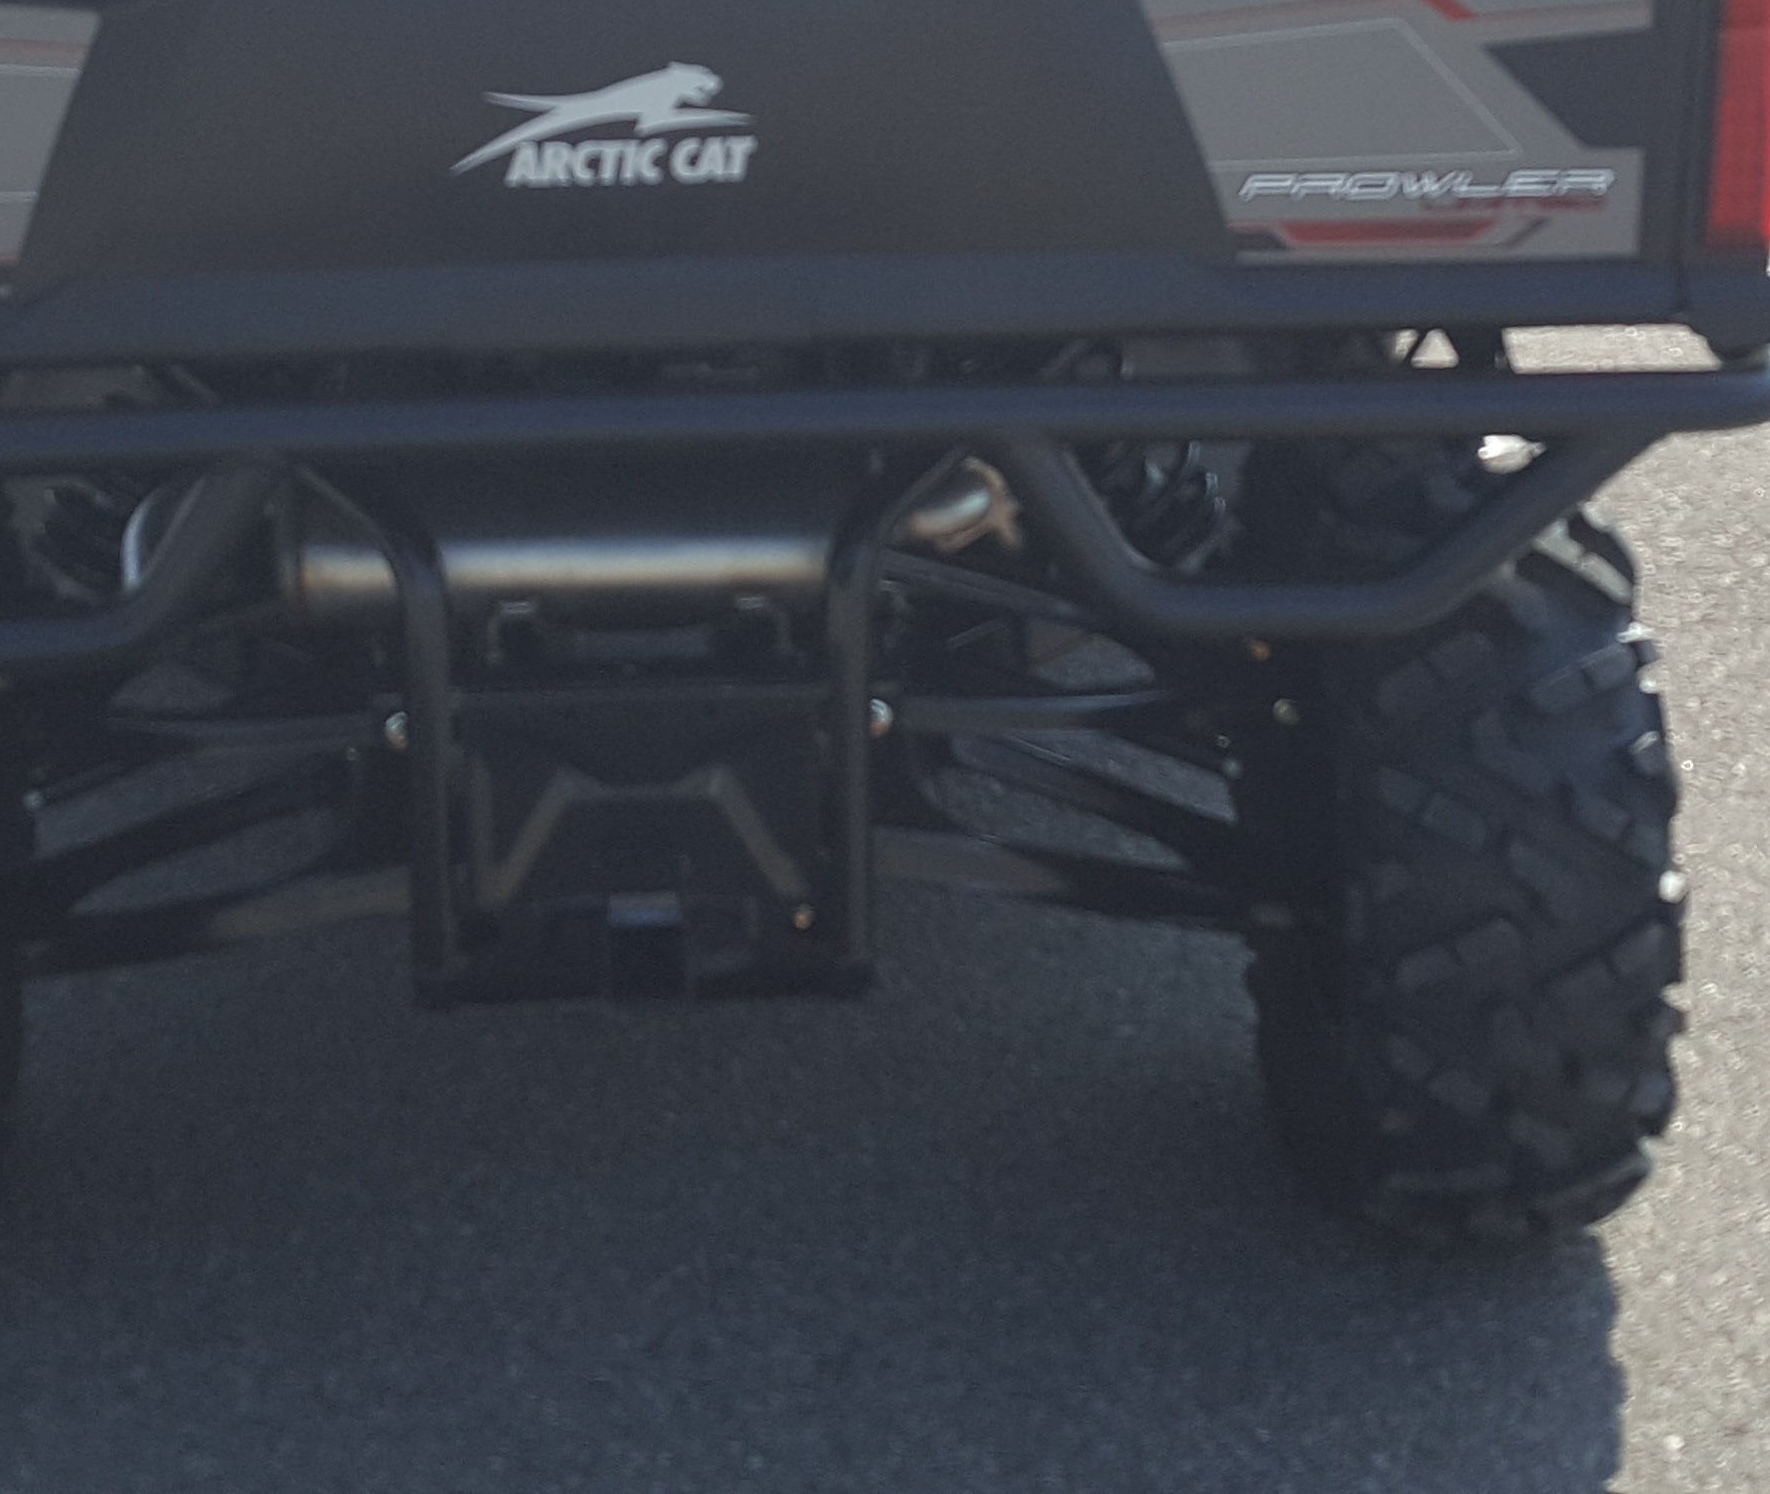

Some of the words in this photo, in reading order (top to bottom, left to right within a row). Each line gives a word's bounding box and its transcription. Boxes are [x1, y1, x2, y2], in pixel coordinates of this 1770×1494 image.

[504, 138, 667, 188] ARCTIC
[669, 135, 758, 184] CAT
[1239, 168, 1616, 202] PROWLER
